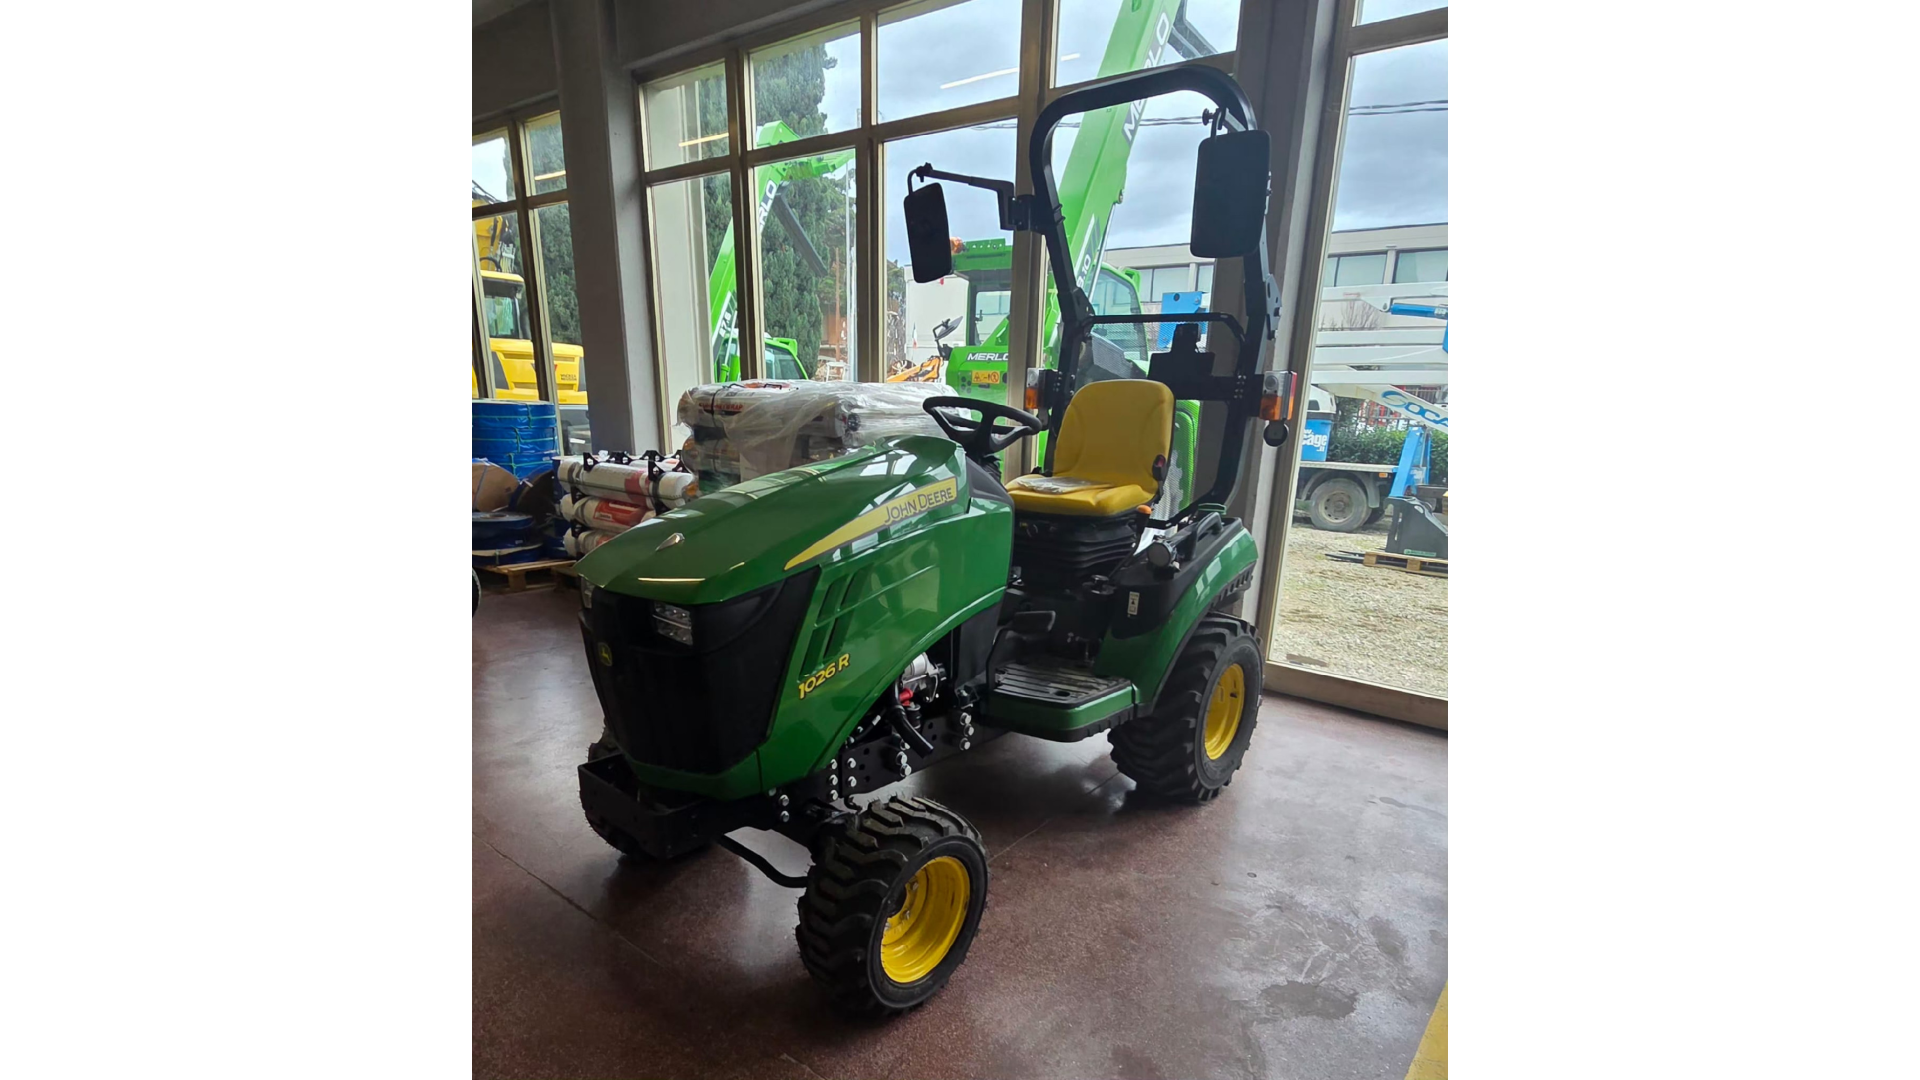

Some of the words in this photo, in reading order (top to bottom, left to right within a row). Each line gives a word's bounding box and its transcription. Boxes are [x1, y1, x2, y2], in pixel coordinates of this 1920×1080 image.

[1123, 12, 1169, 141] MELO
[884, 499, 917, 523] JOHN
[917, 487, 953, 508] DEERE
[798, 662, 836, 699] 1026
[838, 653, 850, 671] R
